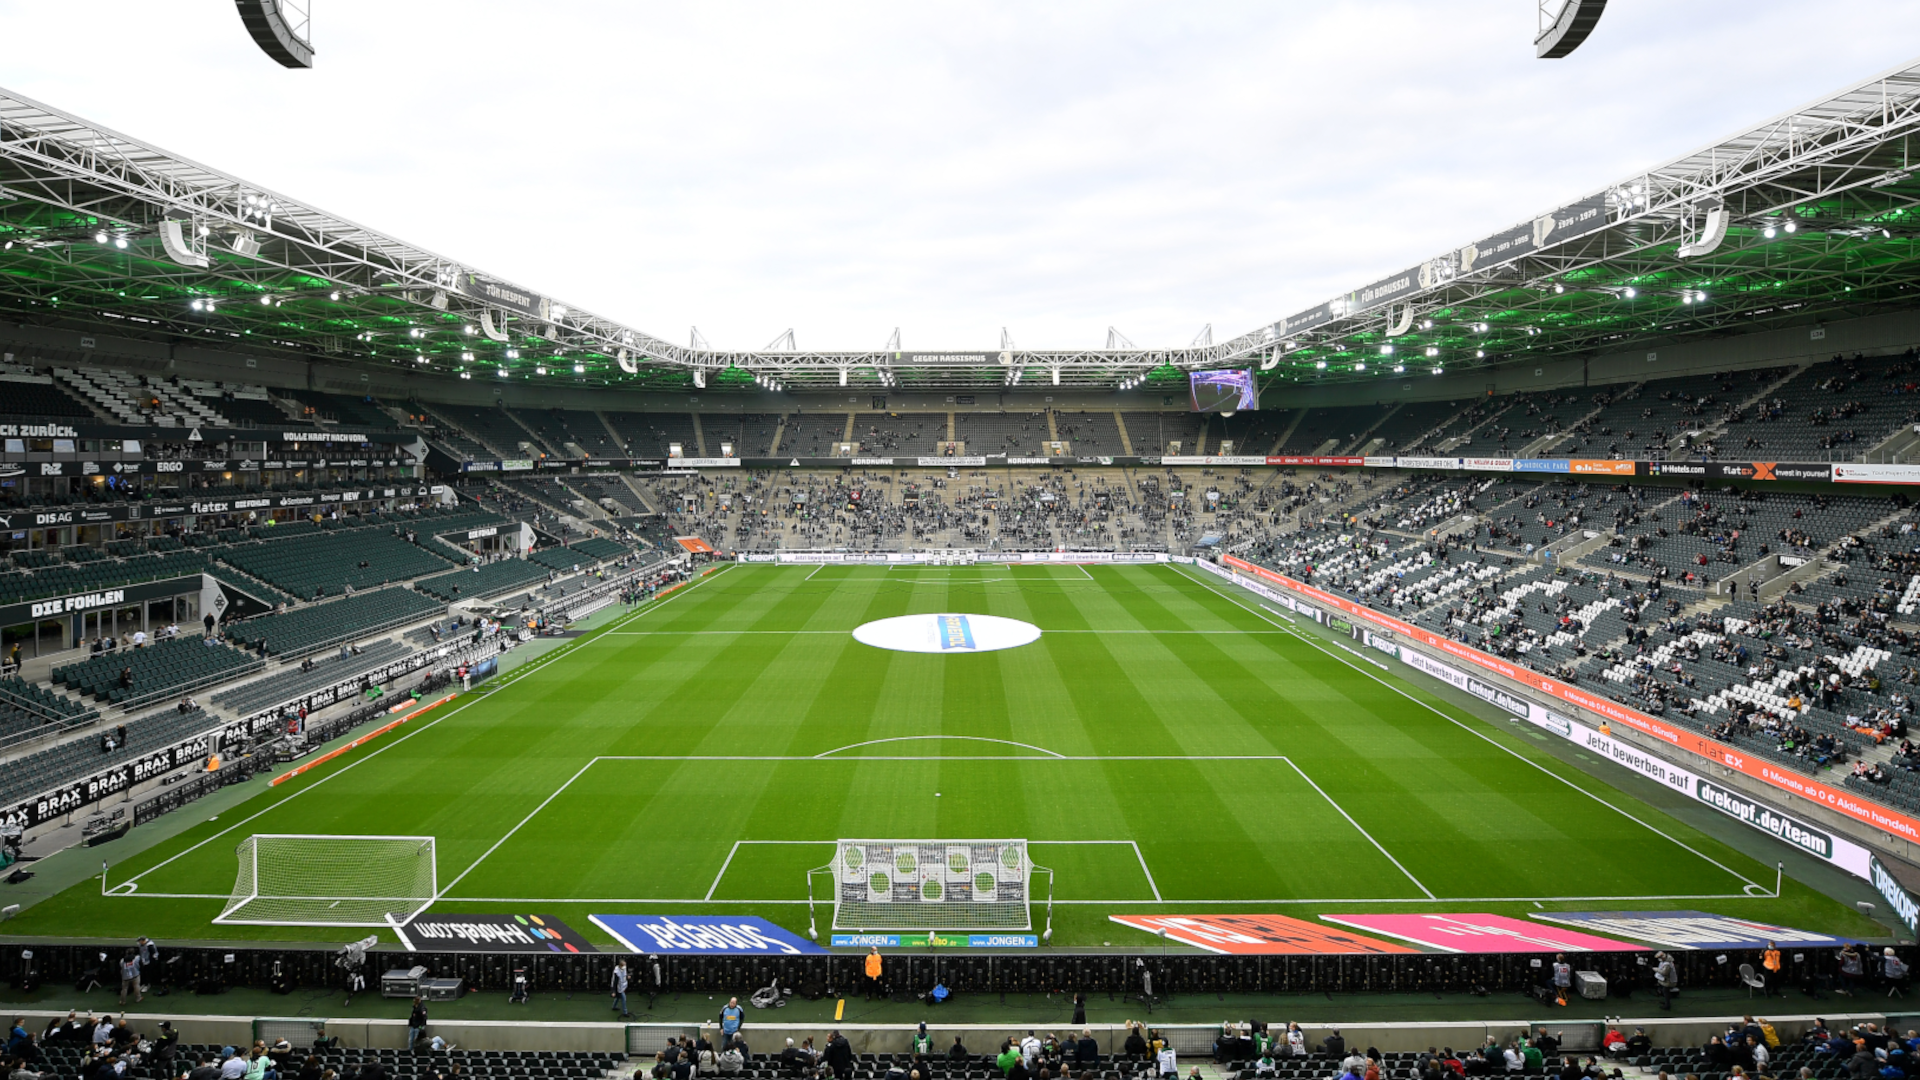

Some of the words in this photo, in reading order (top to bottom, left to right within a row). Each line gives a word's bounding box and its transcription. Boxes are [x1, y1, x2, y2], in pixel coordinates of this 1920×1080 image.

[1557, 216, 1574, 230] 1975
[1579, 208, 1597, 221] 1979
[1361, 288, 1374, 303] FÜR
[1374, 276, 1410, 299] BORUSSIA
[912, 354, 938, 362] GEGEN
[939, 354, 987, 362] RASSISMUS
[20, 423, 78, 437] ZURÜCK.
[283, 432, 307, 441] VOLLE
[308, 433, 330, 441] KRAFT
[330, 433, 348, 442] NACH
[157, 462, 183, 472] ERGO
[1552, 462, 1569, 470] PARK
[1662, 464, 1705, 474] H-Hotels.com
[247, 498, 271, 507] FOHLEN
[31, 600, 63, 617] DIE
[65, 590, 124, 612] FOHLEN
[1411, 654, 1424, 669] Jetzt
[1425, 659, 1453, 681] bewerben
[1453, 673, 1464, 686] auf
[1469, 680, 1528, 717] drekopf.de/team
[311, 691, 335, 706] BRAX
[252, 713, 279, 730] BRAX
[176, 738, 208, 759] BRAX
[135, 754, 170, 776] BRAX
[89, 770, 128, 794] BRAX
[38, 788, 81, 815] BRAX
[1586, 732, 1610, 754] Jetzt
[1613, 743, 1665, 780] bewerben
[1669, 772, 1689, 790] auf
[1701, 785, 1827, 855] drekopf.de/team
[1762, 768, 1769, 777] 6
[1770, 770, 1803, 791] Monate
[1805, 784, 1817, 797] ab
[1818, 791, 1826, 800] 0
[1827, 794, 1835, 804] €
[1837, 797, 1870, 818] Aktien
[1871, 810, 1919, 838] handeln.
[1875, 863, 1919, 931] DREKOPF
[414, 922, 535, 945] H-Hotels.com
